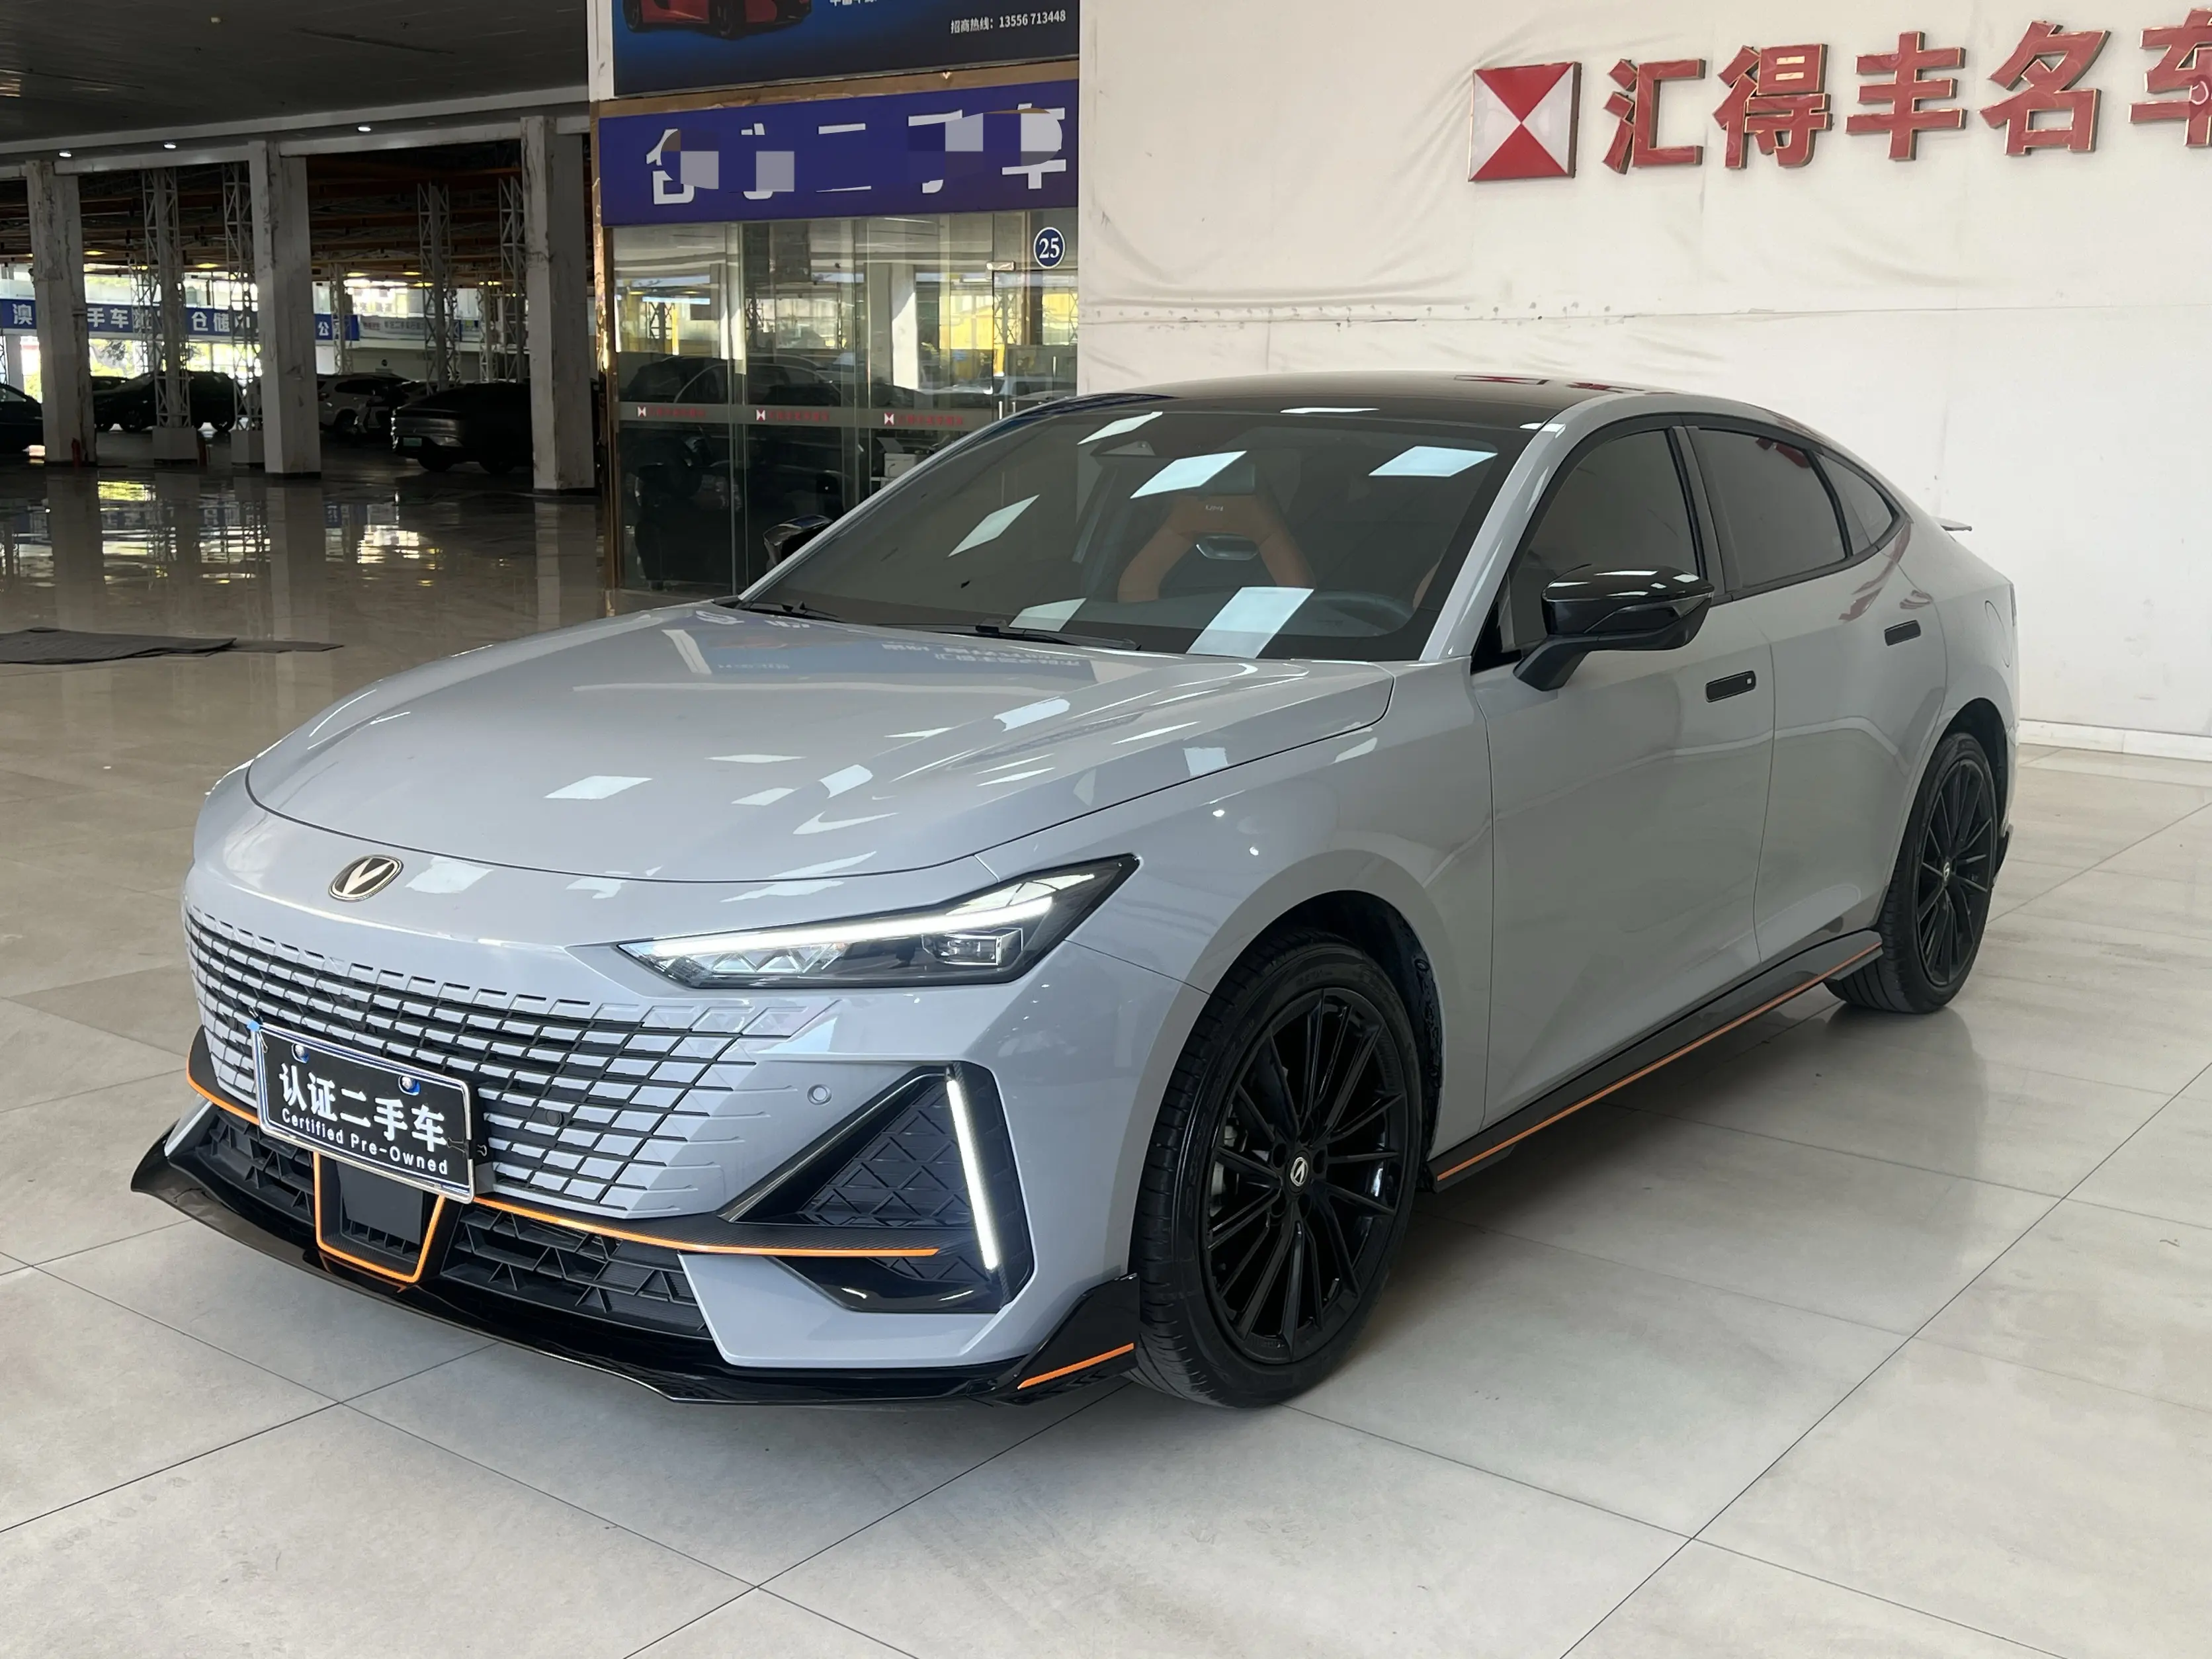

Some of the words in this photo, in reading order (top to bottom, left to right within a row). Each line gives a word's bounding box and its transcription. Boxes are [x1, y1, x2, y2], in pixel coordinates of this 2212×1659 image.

[999, 15, 1028, 28] 13556
[1030, 9, 1066, 24] 713448
[1602, 7, 2212, 175] 汇得丰名车
[1039, 237, 1060, 259] 25
[278, 1062, 447, 1152] 认证二手车
[282, 1108, 344, 1144] Certified
[351, 1133, 448, 1175] Pre-Owned
